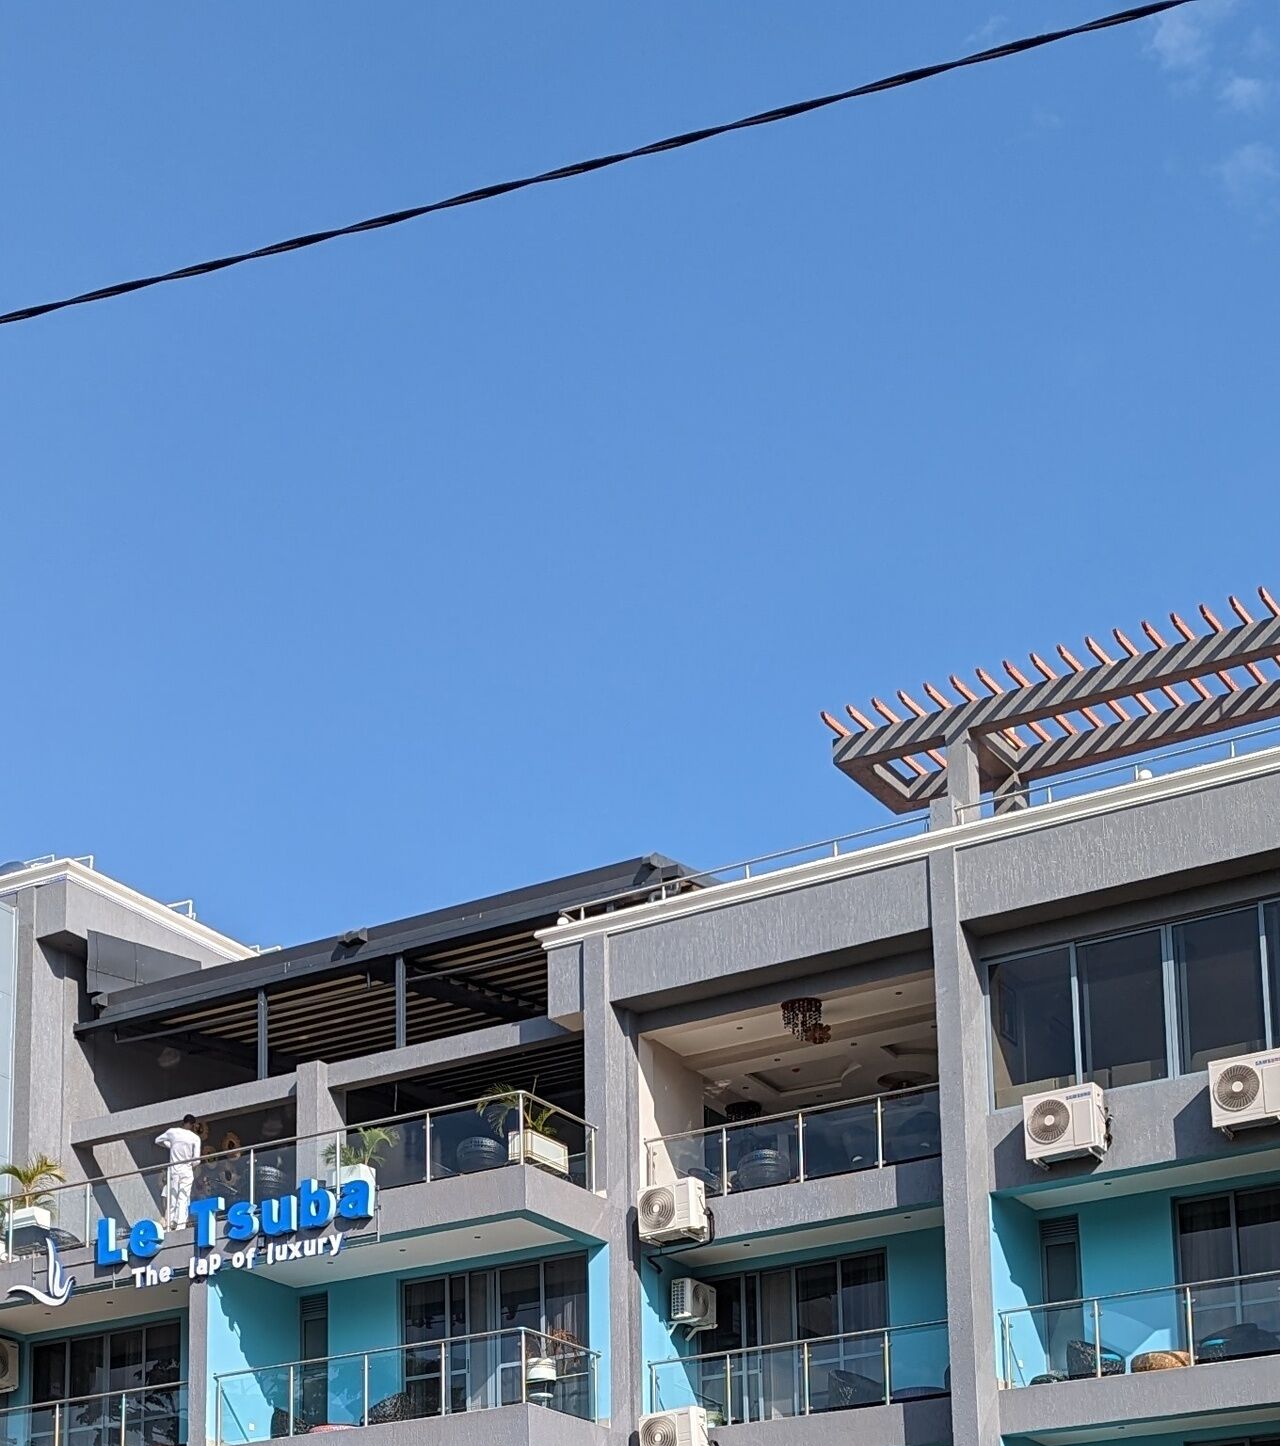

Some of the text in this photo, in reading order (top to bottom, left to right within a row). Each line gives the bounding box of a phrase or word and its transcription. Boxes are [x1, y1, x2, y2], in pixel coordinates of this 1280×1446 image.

[1065, 1090, 1091, 1101] SAMSUNG
[97, 1178, 376, 1266] Le Tsuba
[132, 1264, 171, 1288] The
[232, 1247, 257, 1269] of
[267, 1232, 343, 1264] luxury
